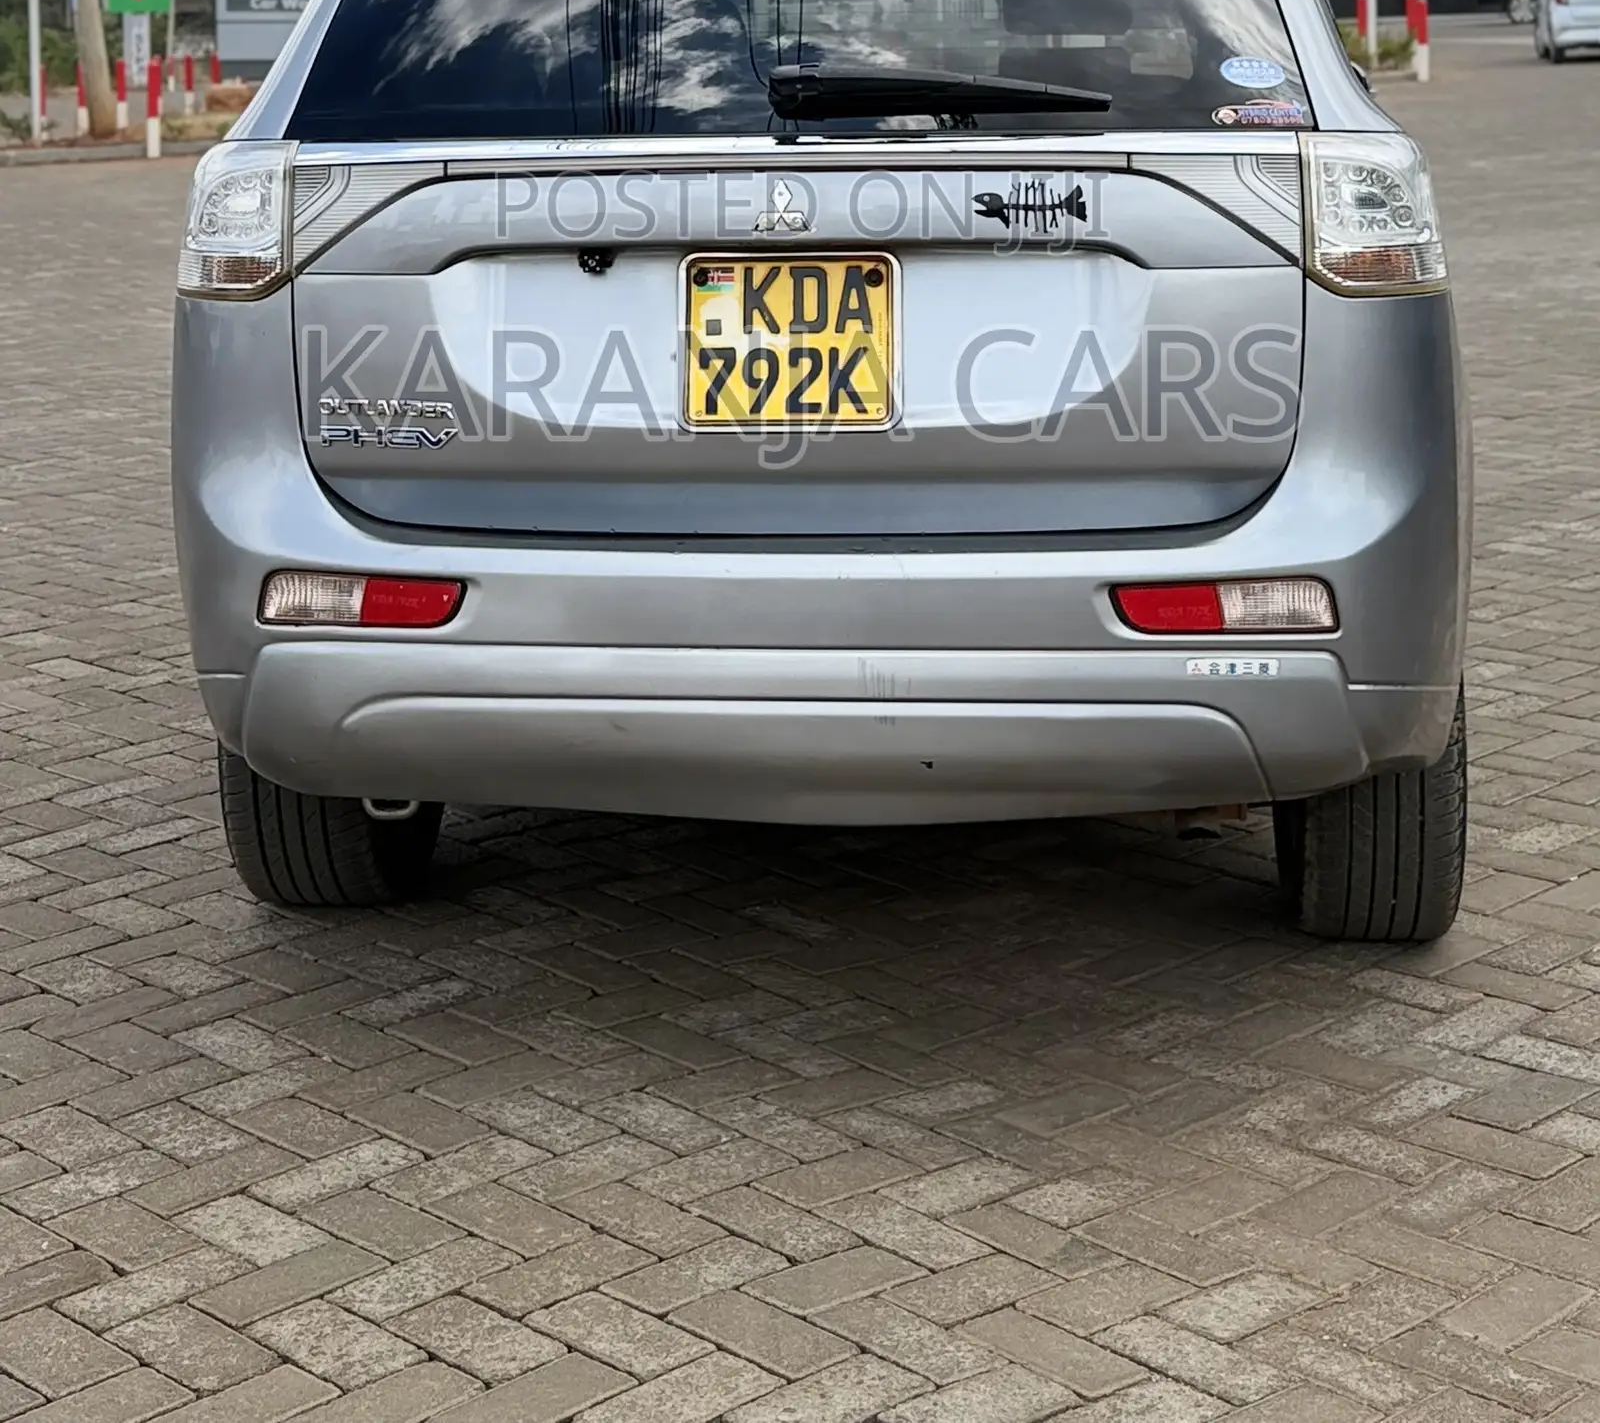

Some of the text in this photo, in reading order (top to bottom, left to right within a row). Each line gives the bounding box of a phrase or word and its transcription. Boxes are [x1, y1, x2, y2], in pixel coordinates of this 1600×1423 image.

[743, 265, 873, 334] KDA
[699, 346, 869, 415] 792K
[318, 398, 455, 419] OUTLANDER
[319, 425, 459, 449] PHEV
